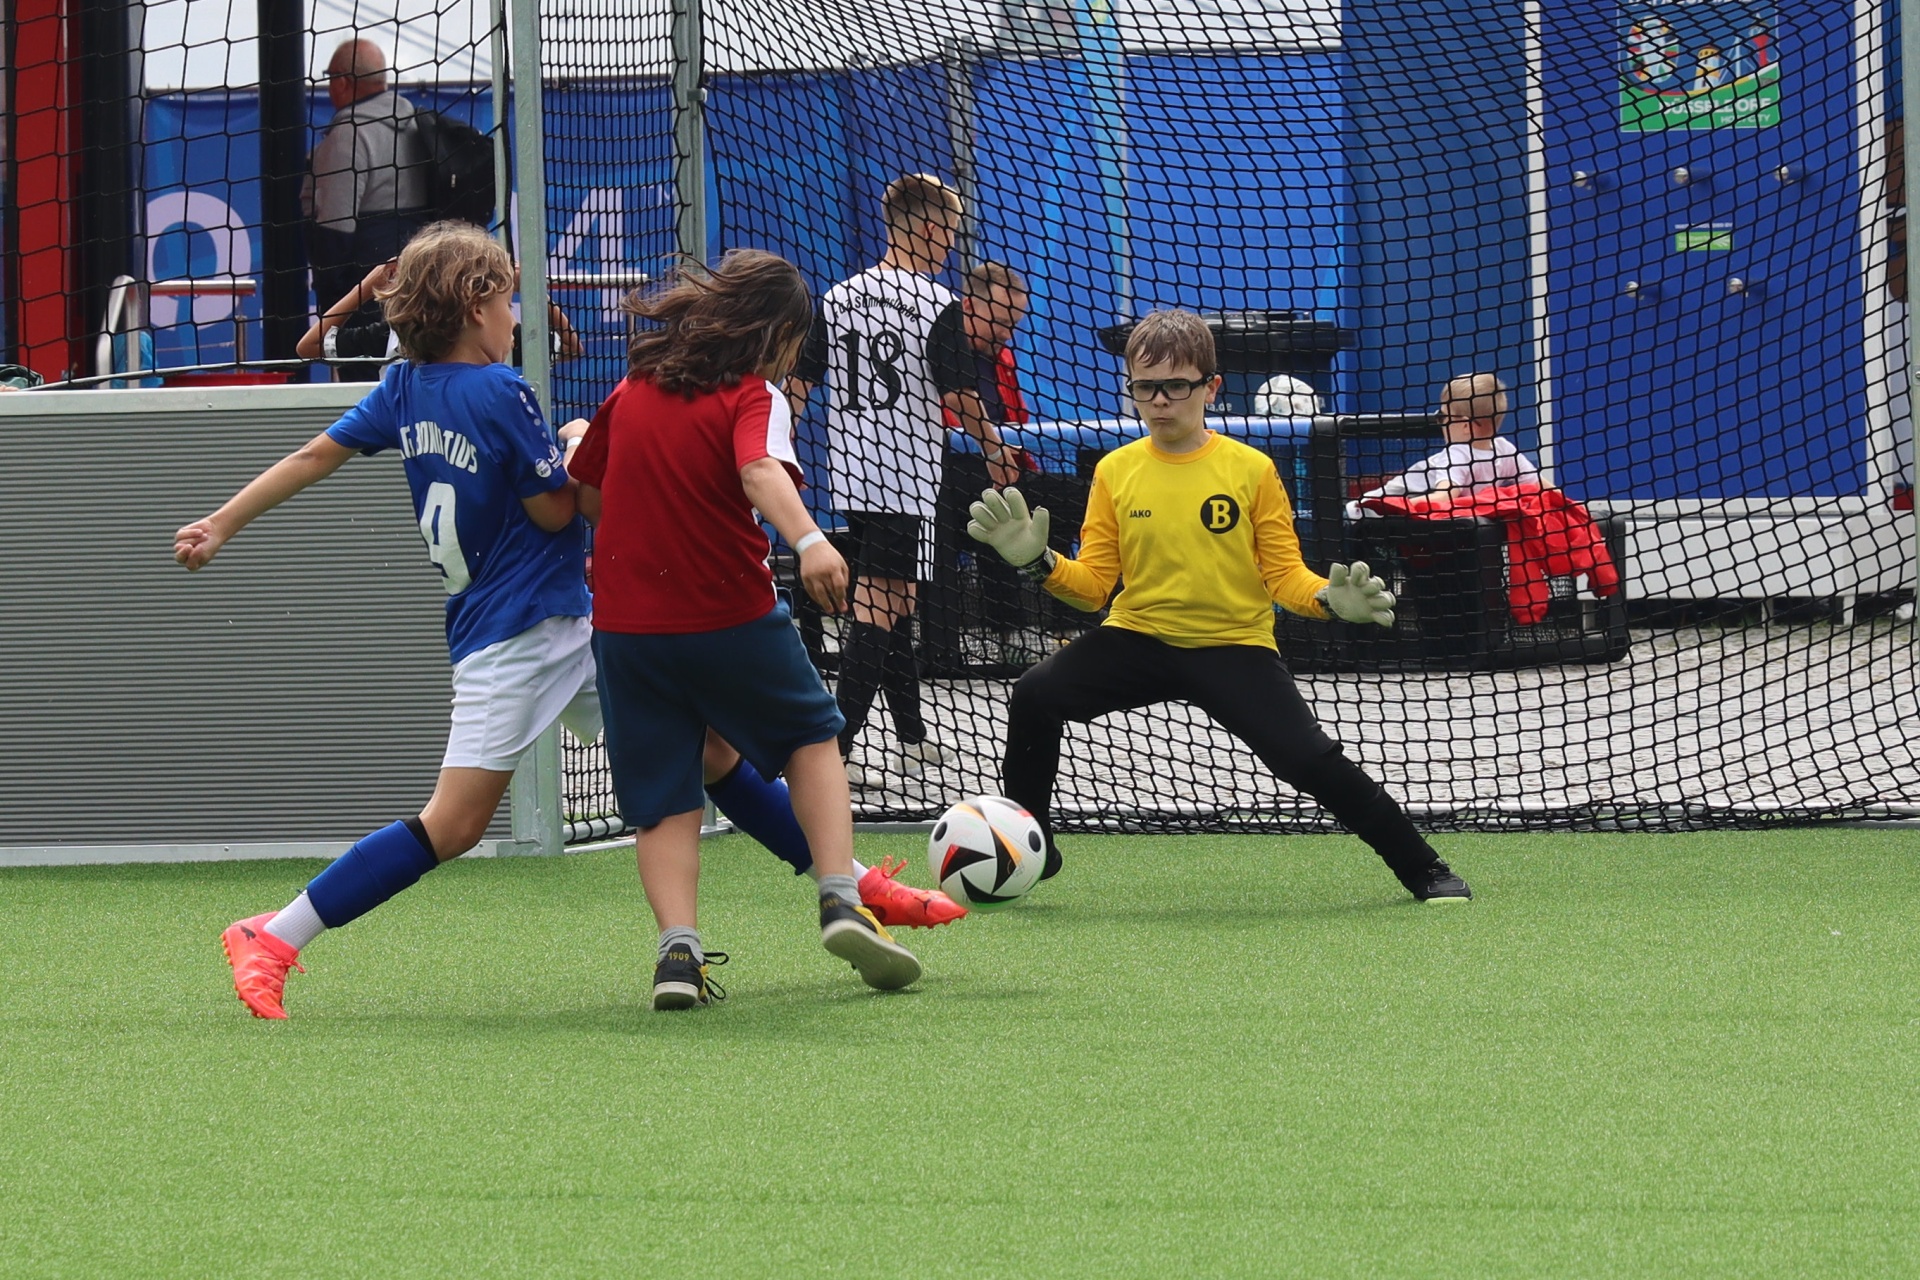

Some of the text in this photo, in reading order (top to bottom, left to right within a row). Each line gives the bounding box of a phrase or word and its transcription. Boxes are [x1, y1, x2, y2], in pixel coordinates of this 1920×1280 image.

[1659, 98, 1772, 115] DÜSSELDORF
[1747, 114, 1771, 123] CTY
[838, 329, 902, 411] 18
[1129, 509, 1152, 518] JAKO
[1209, 499, 1231, 529] B
[420, 481, 473, 596] 9
[668, 951, 690, 961] 1909
